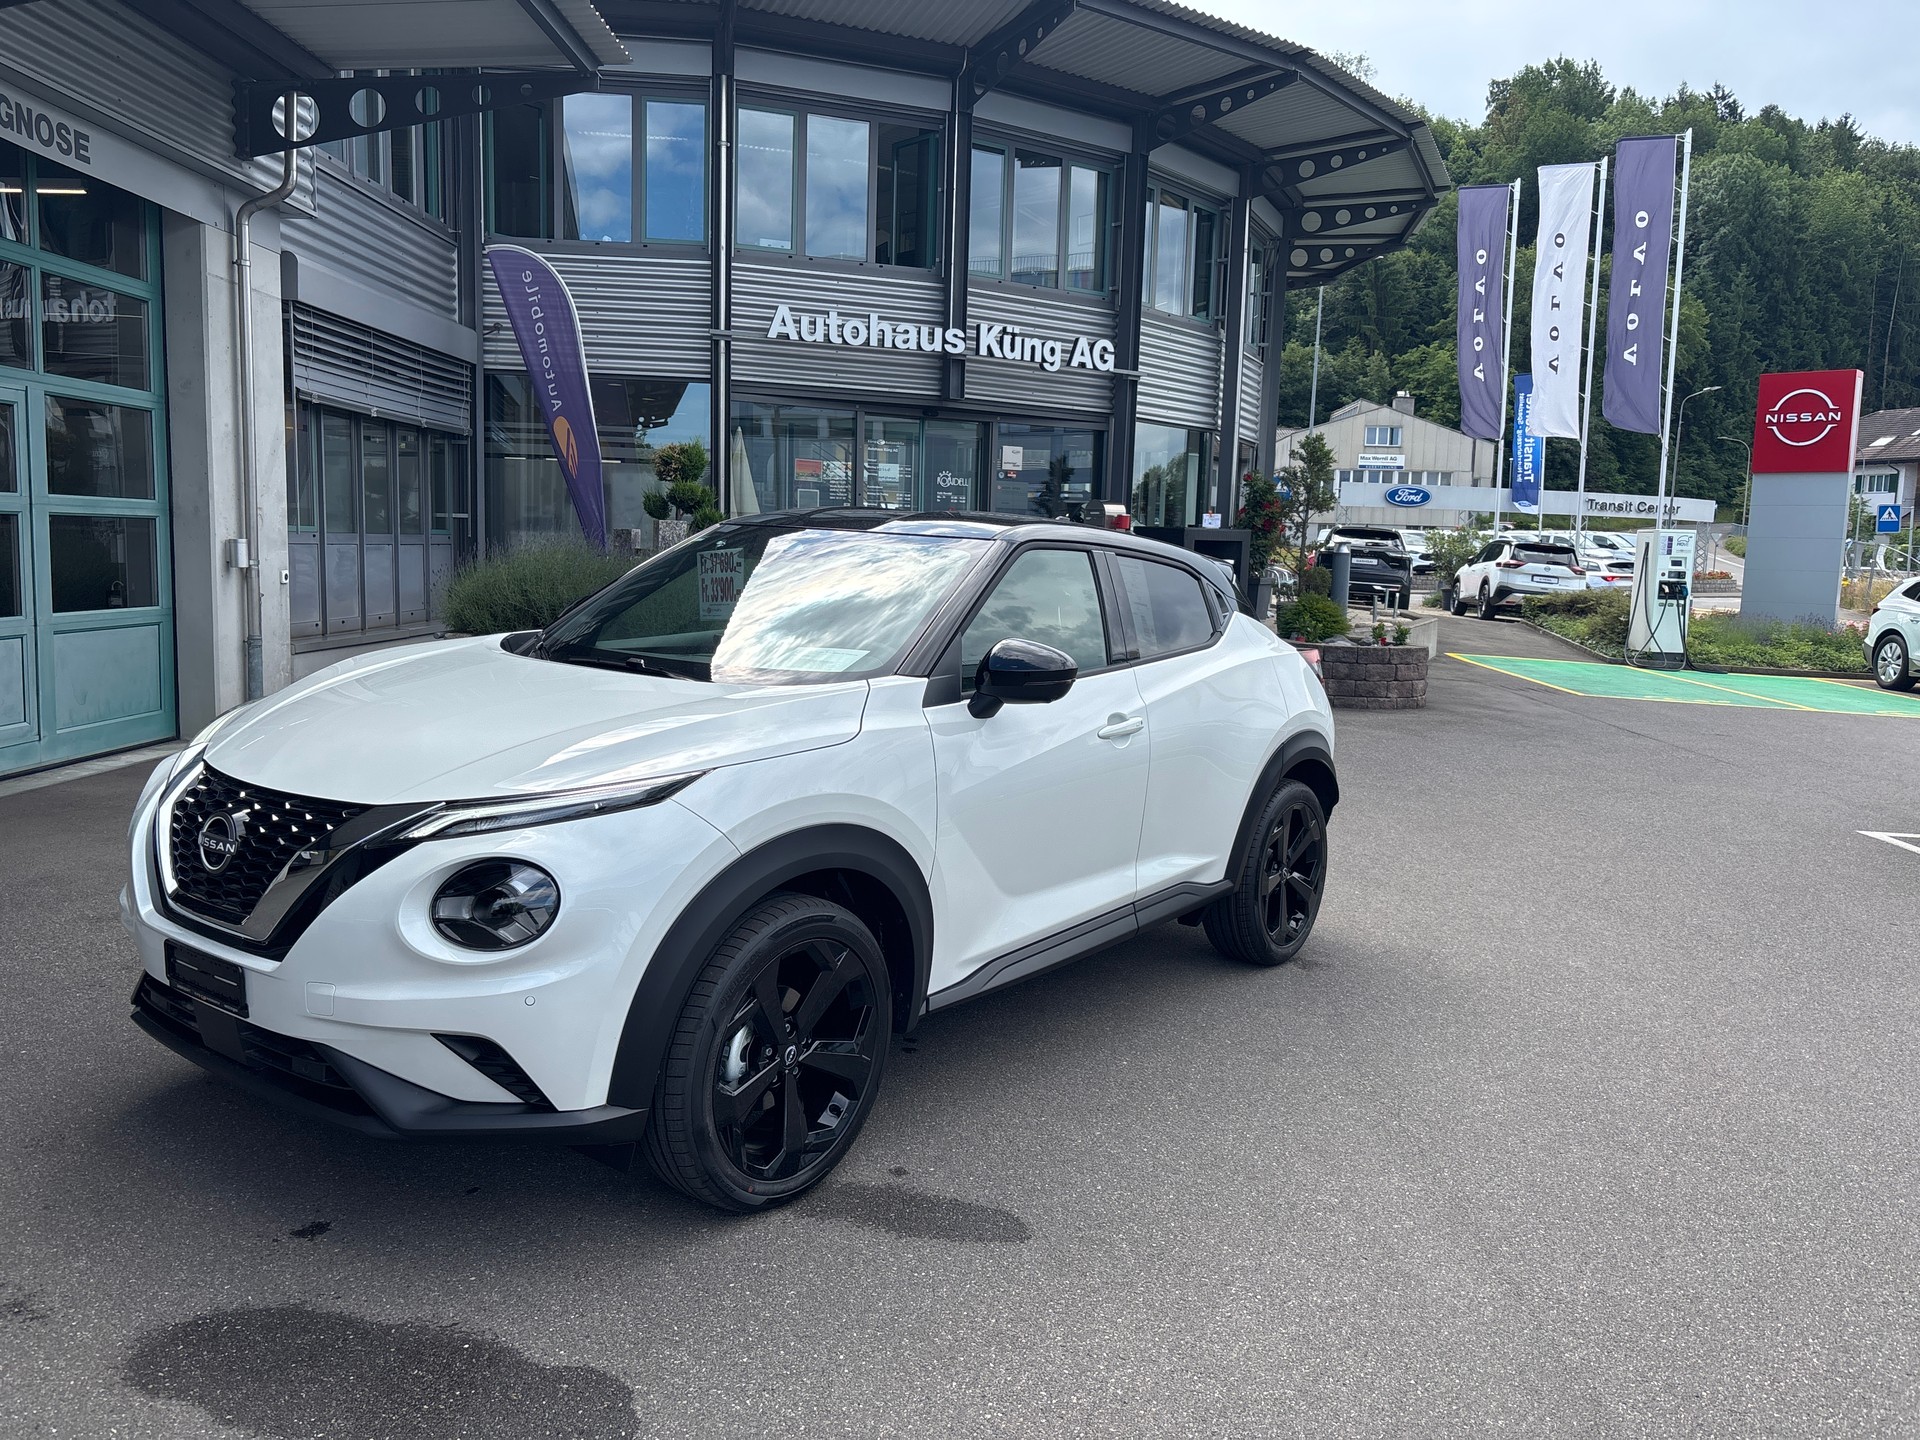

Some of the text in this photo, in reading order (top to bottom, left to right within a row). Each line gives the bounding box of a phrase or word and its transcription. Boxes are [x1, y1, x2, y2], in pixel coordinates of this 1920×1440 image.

[0, 93, 91, 165] GNOSE
[766, 304, 1115, 372] Autohaus Küng AG
[1765, 411, 1841, 424] NISSAN
[1394, 488, 1424, 502] Ford
[1587, 498, 1633, 513] Transit
